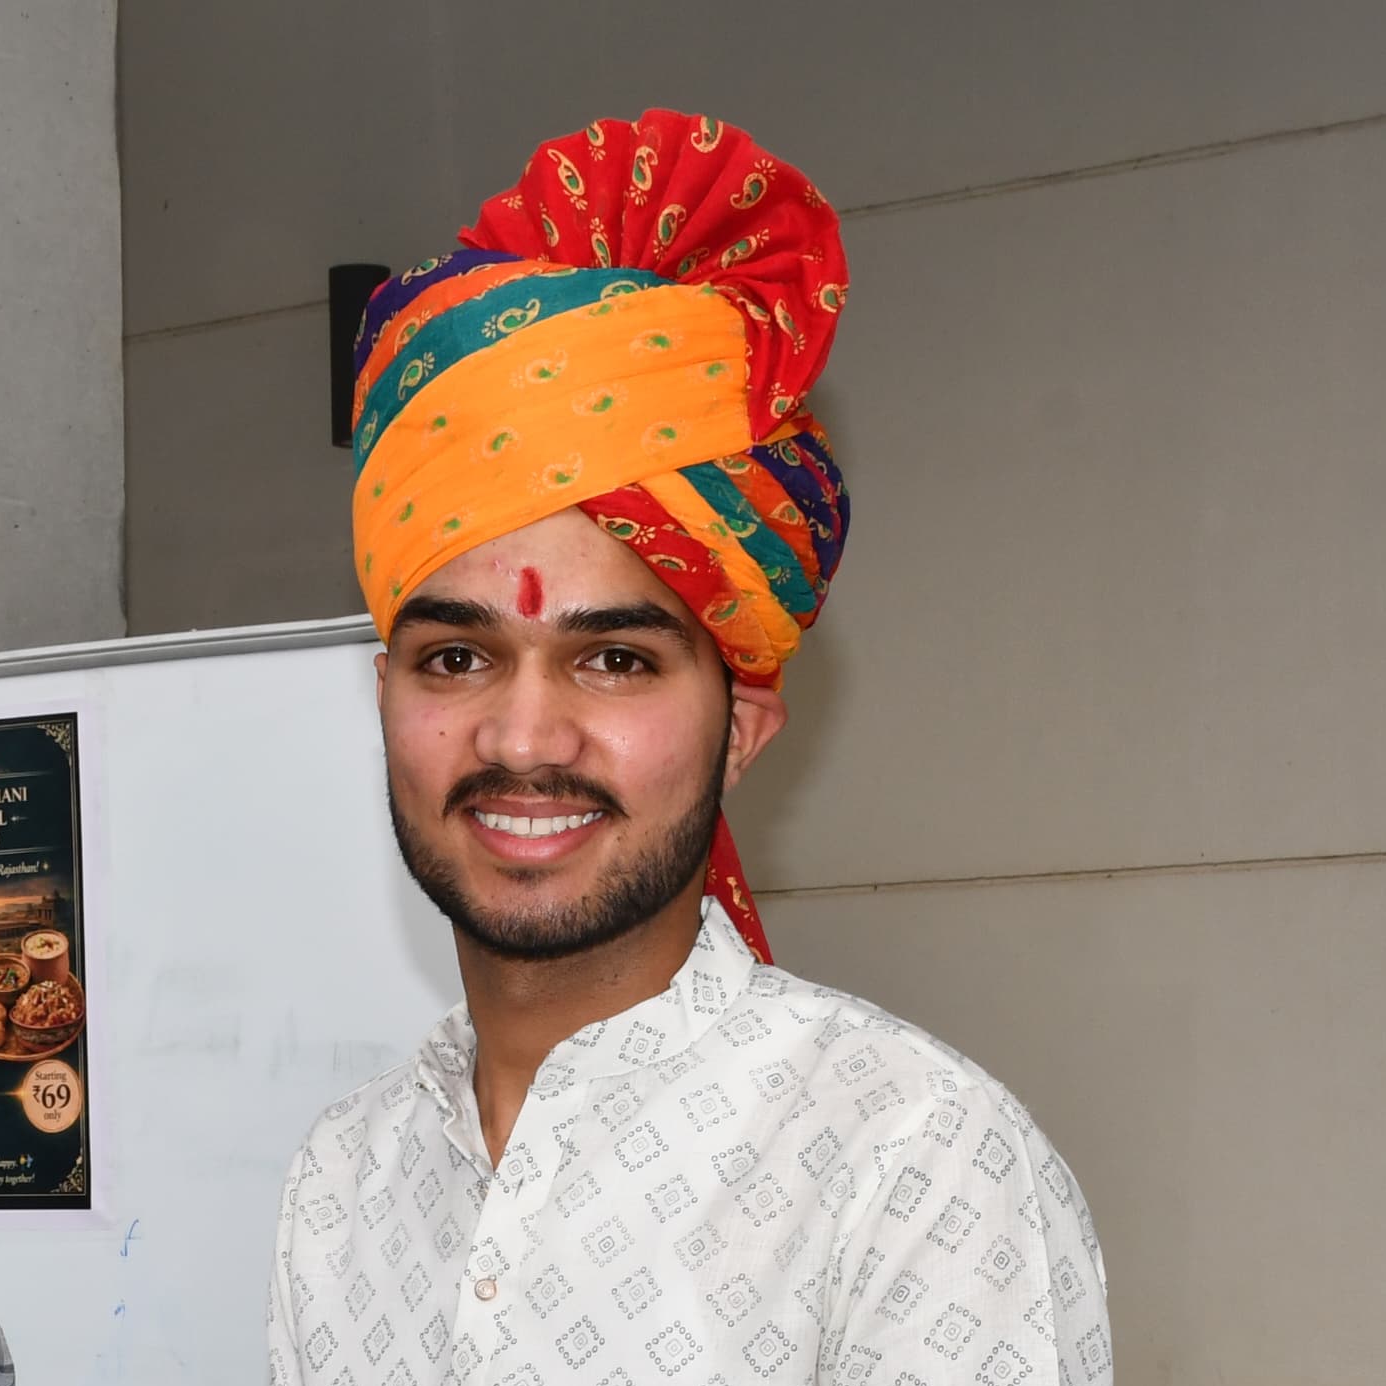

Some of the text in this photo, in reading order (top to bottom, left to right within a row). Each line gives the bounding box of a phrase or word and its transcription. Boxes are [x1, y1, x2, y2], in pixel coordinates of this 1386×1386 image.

[35, 1070, 67, 1082] Starting
[32, 1084, 71, 1109] ₹69
[44, 1110, 61, 1122] only
